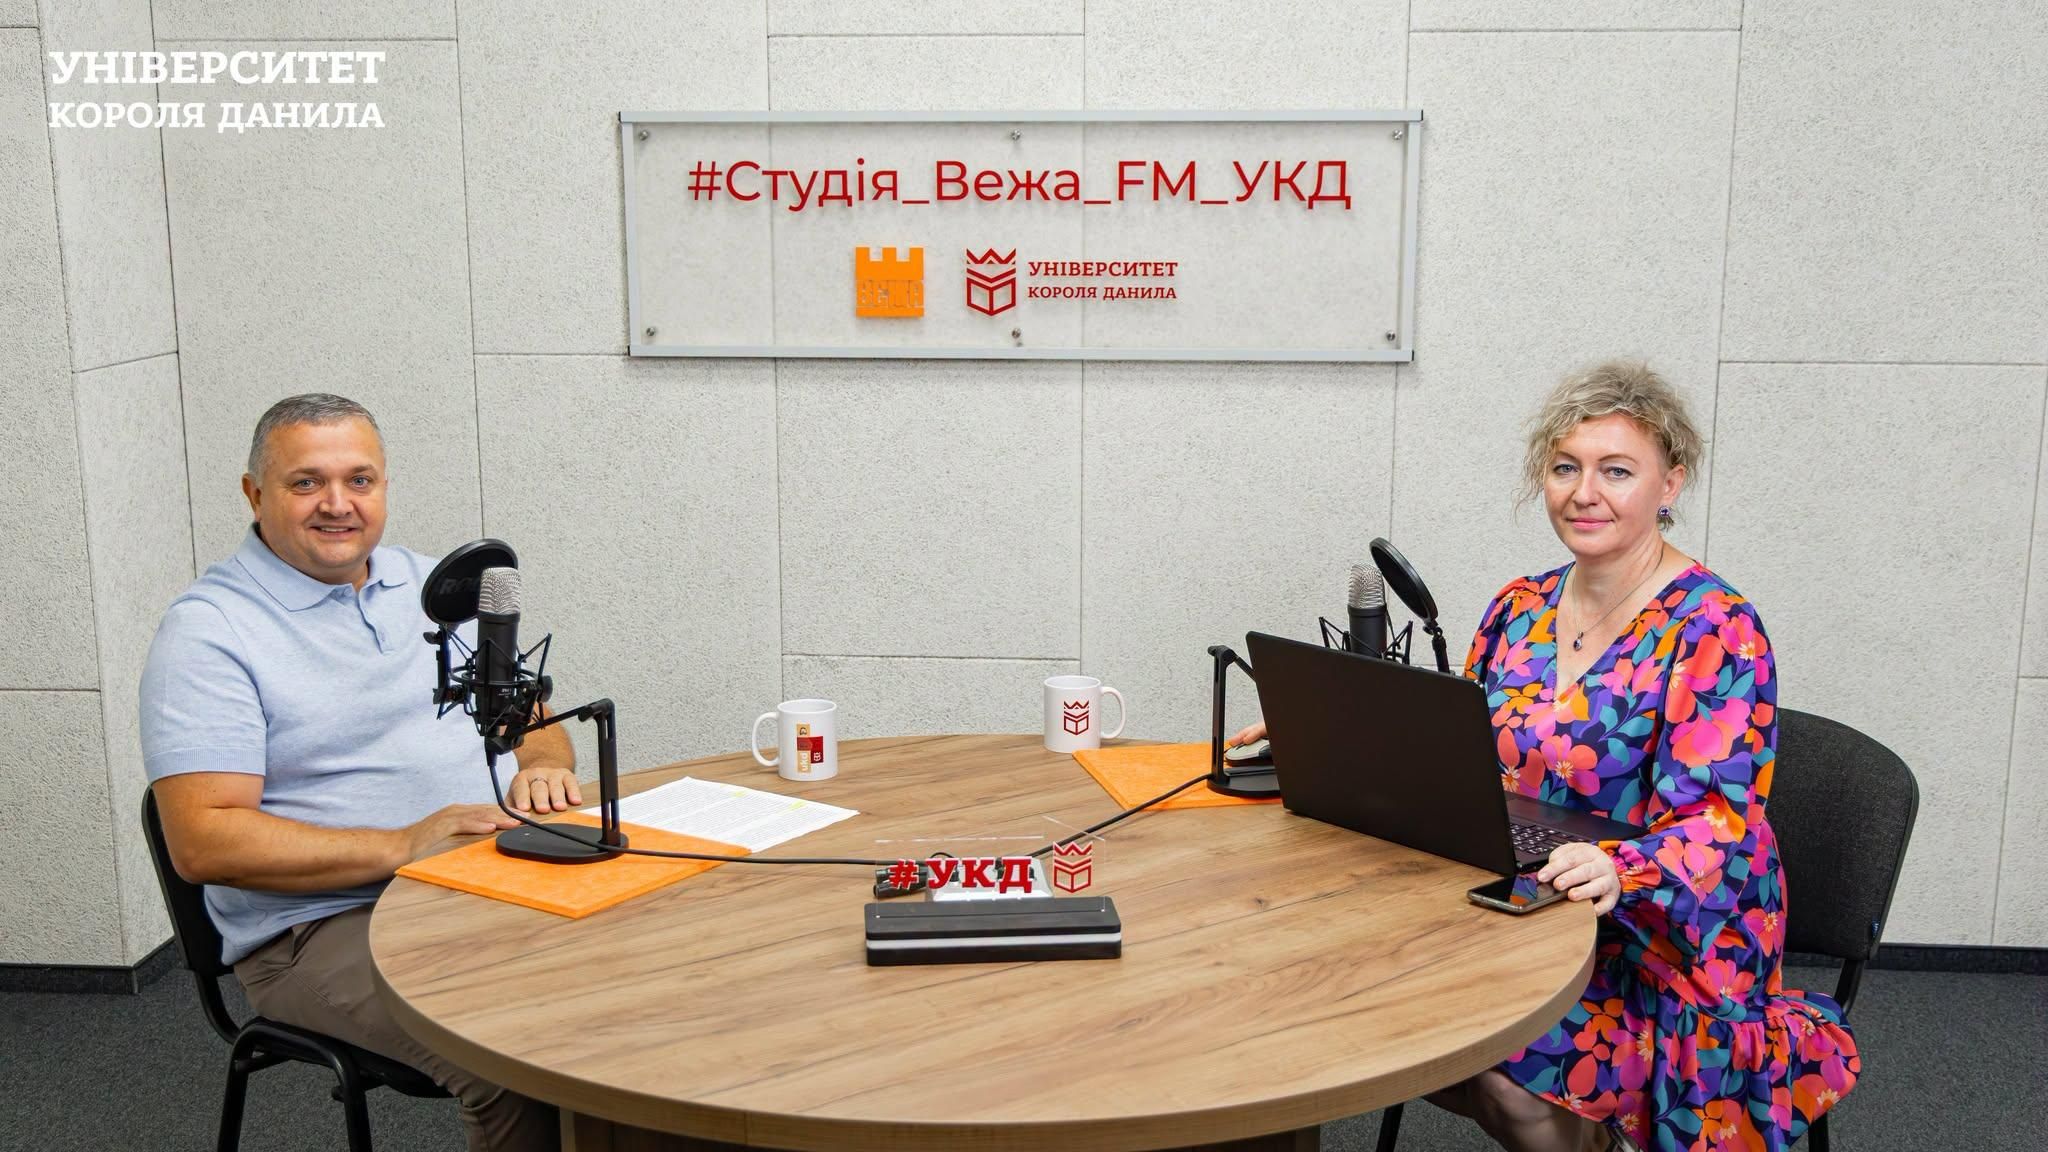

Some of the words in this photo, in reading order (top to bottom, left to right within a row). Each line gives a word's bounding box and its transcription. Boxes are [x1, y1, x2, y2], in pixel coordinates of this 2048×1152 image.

[687, 157, 1352, 211] #Студія_Вежа_FM_УКД
[1027, 261, 1179, 278] УНІВЕРСИТЕТ
[1027, 286, 1098, 299] КОРОЛЯ
[1102, 287, 1178, 301] ДАНИЛА
